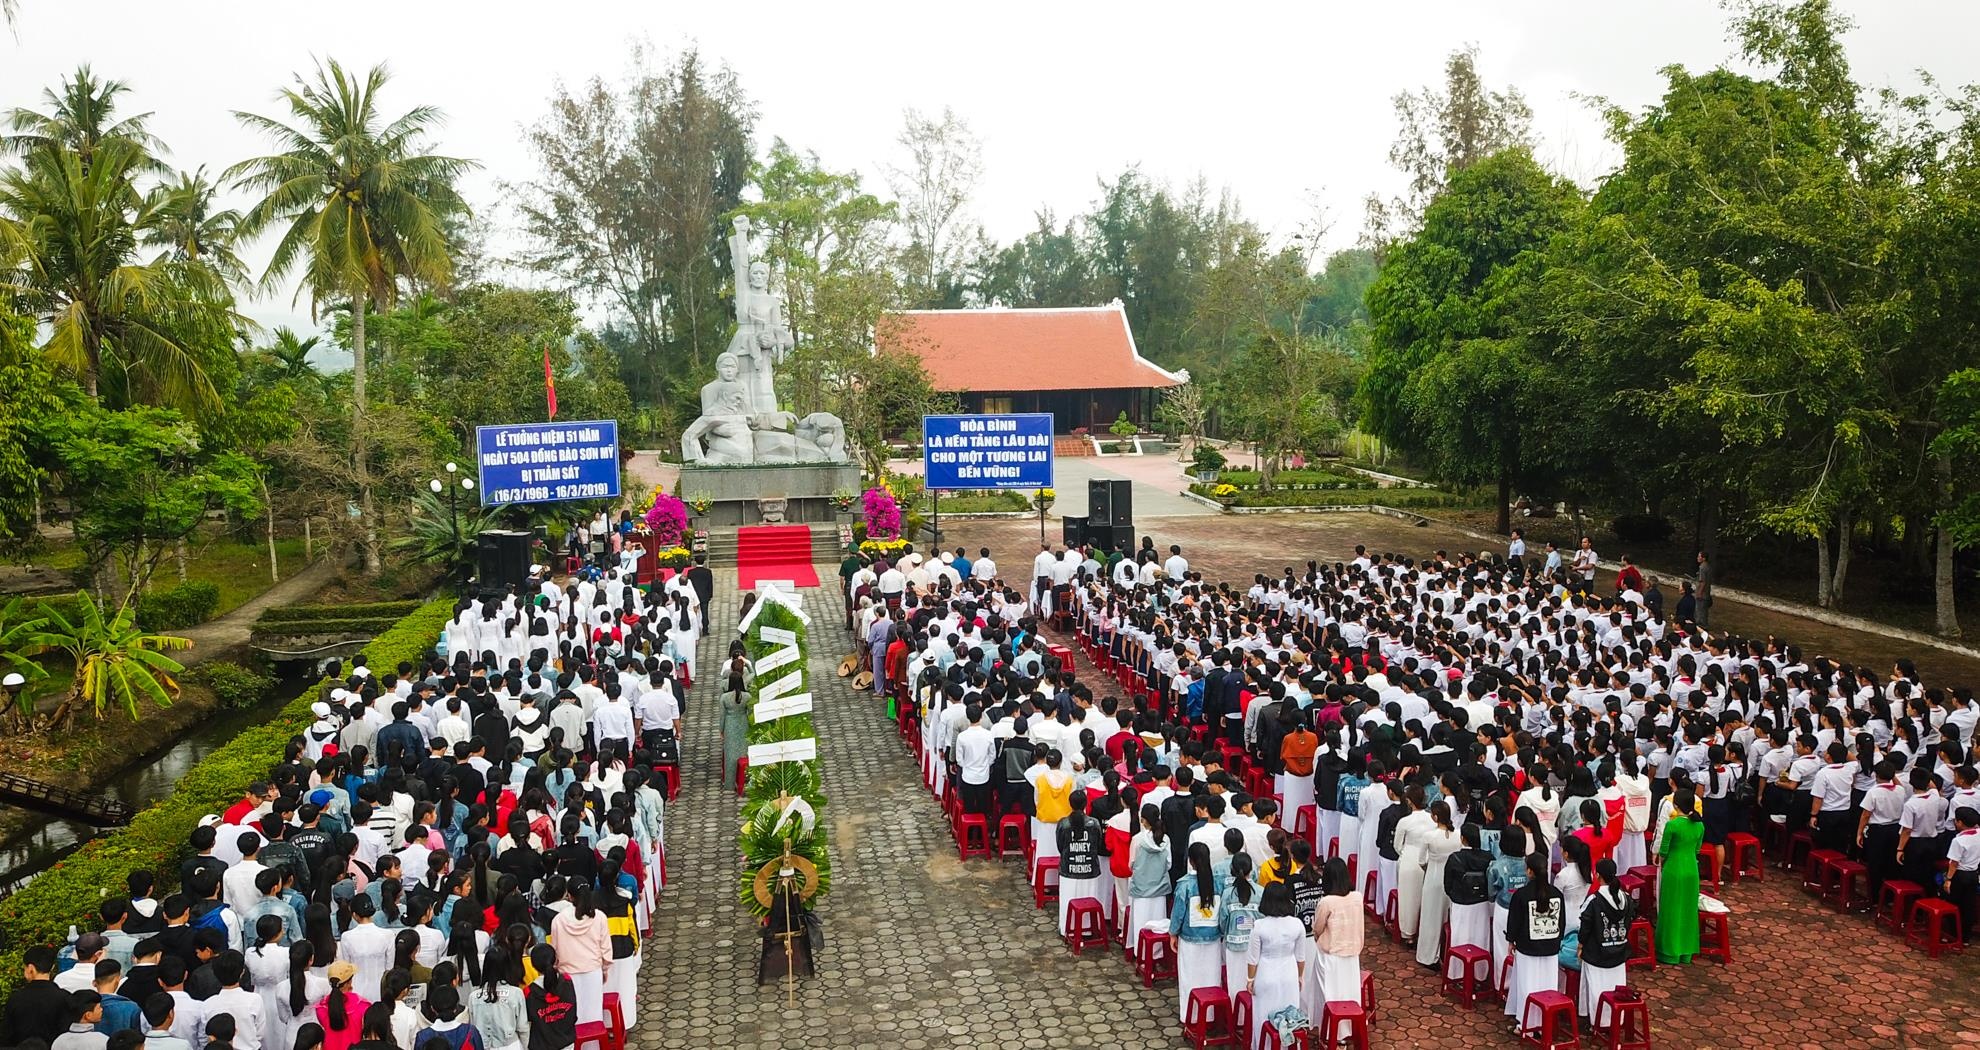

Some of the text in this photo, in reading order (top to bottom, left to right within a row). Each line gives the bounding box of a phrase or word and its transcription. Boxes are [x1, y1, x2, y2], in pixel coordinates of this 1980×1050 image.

[960, 418, 1017, 432] HÒA BÌNH
[541, 429, 565, 447] NIỆM
[566, 430, 577, 443] 51
[578, 428, 600, 443] NĂM
[929, 434, 943, 448] LÀ
[1003, 433, 1026, 447] LÂU
[483, 450, 509, 466] NGÀY
[510, 451, 530, 465] 504
[558, 446, 579, 462] BÀO
[579, 446, 599, 461] SƠN
[599, 443, 614, 460] MỸ
[931, 449, 1047, 465] CHO MỘT TƯƠNG LAI
[521, 464, 580, 485] BỊ THẢM SÁT
[494, 486, 549, 502] (16/3/1968
[555, 482, 609, 498] 16/3/2019)
[1069, 842, 1091, 852] MONEY
[1075, 855, 1086, 863] NOT
[1069, 864, 1092, 873] FRIENDS
